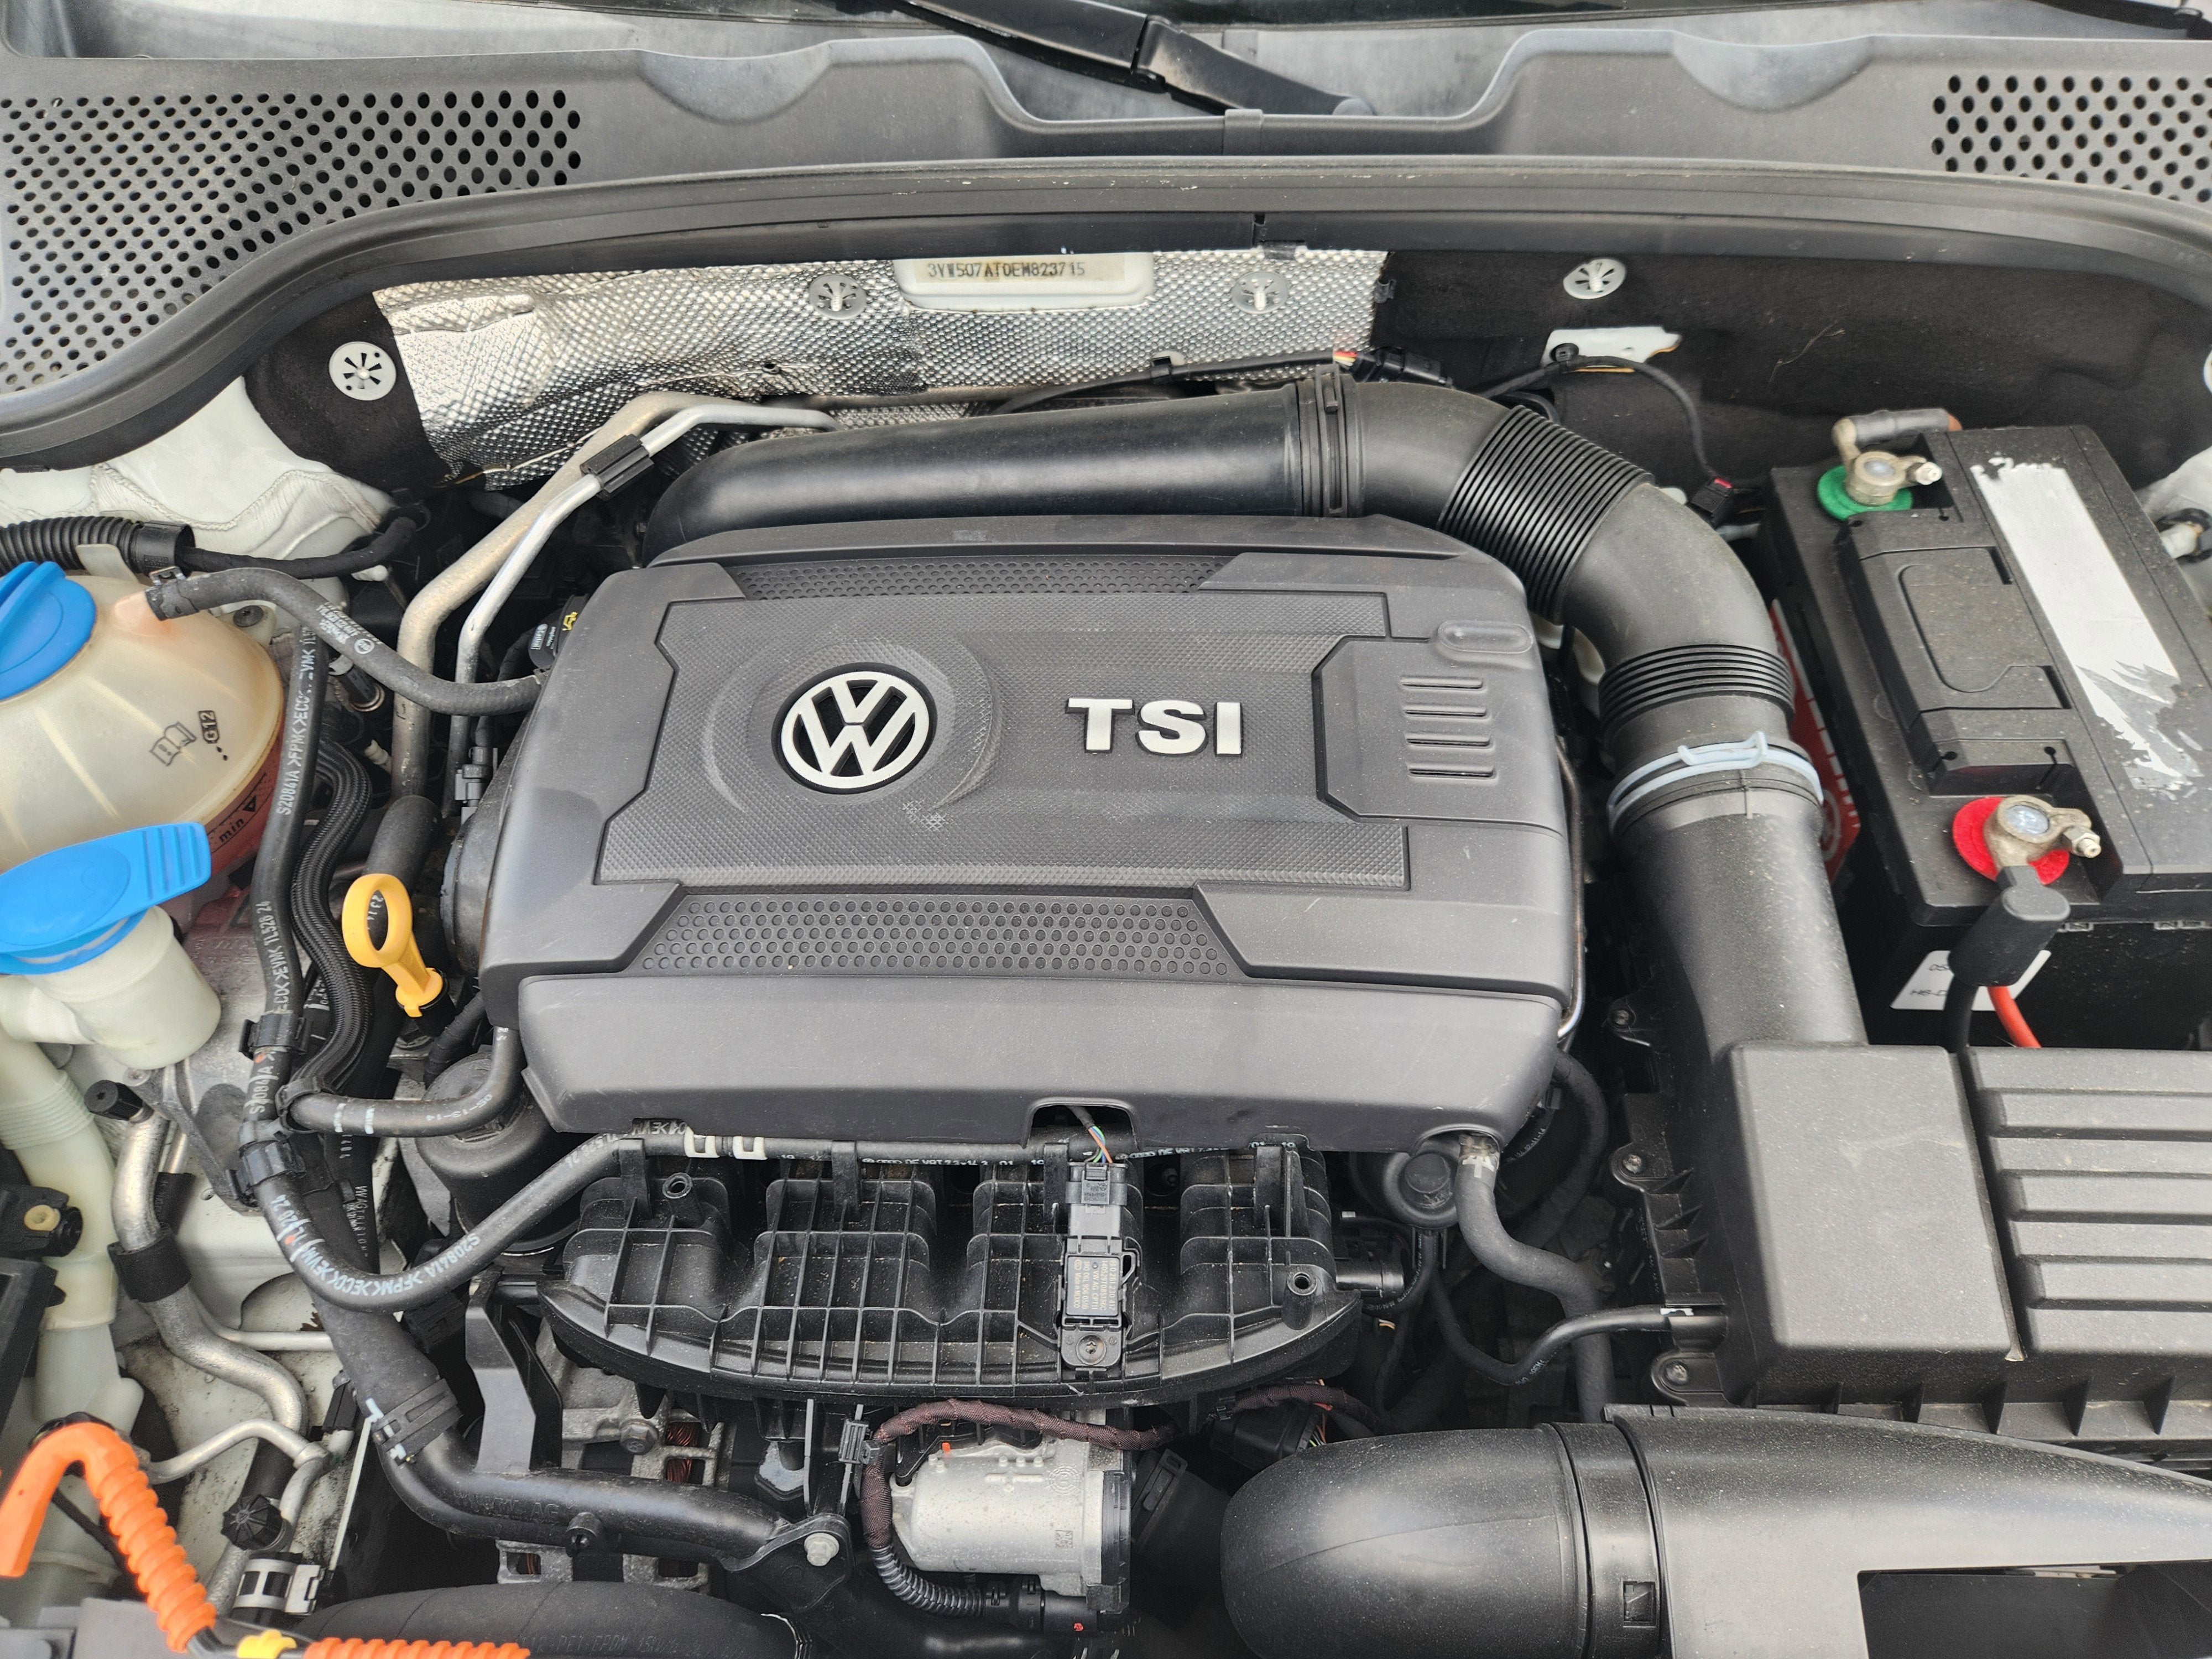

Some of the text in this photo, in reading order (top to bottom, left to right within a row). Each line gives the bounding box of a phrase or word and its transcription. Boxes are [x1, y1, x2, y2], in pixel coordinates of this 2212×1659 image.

[199, 711, 220, 743] G12
[1066, 697, 1243, 757] TSI
[219, 818, 244, 843] min
